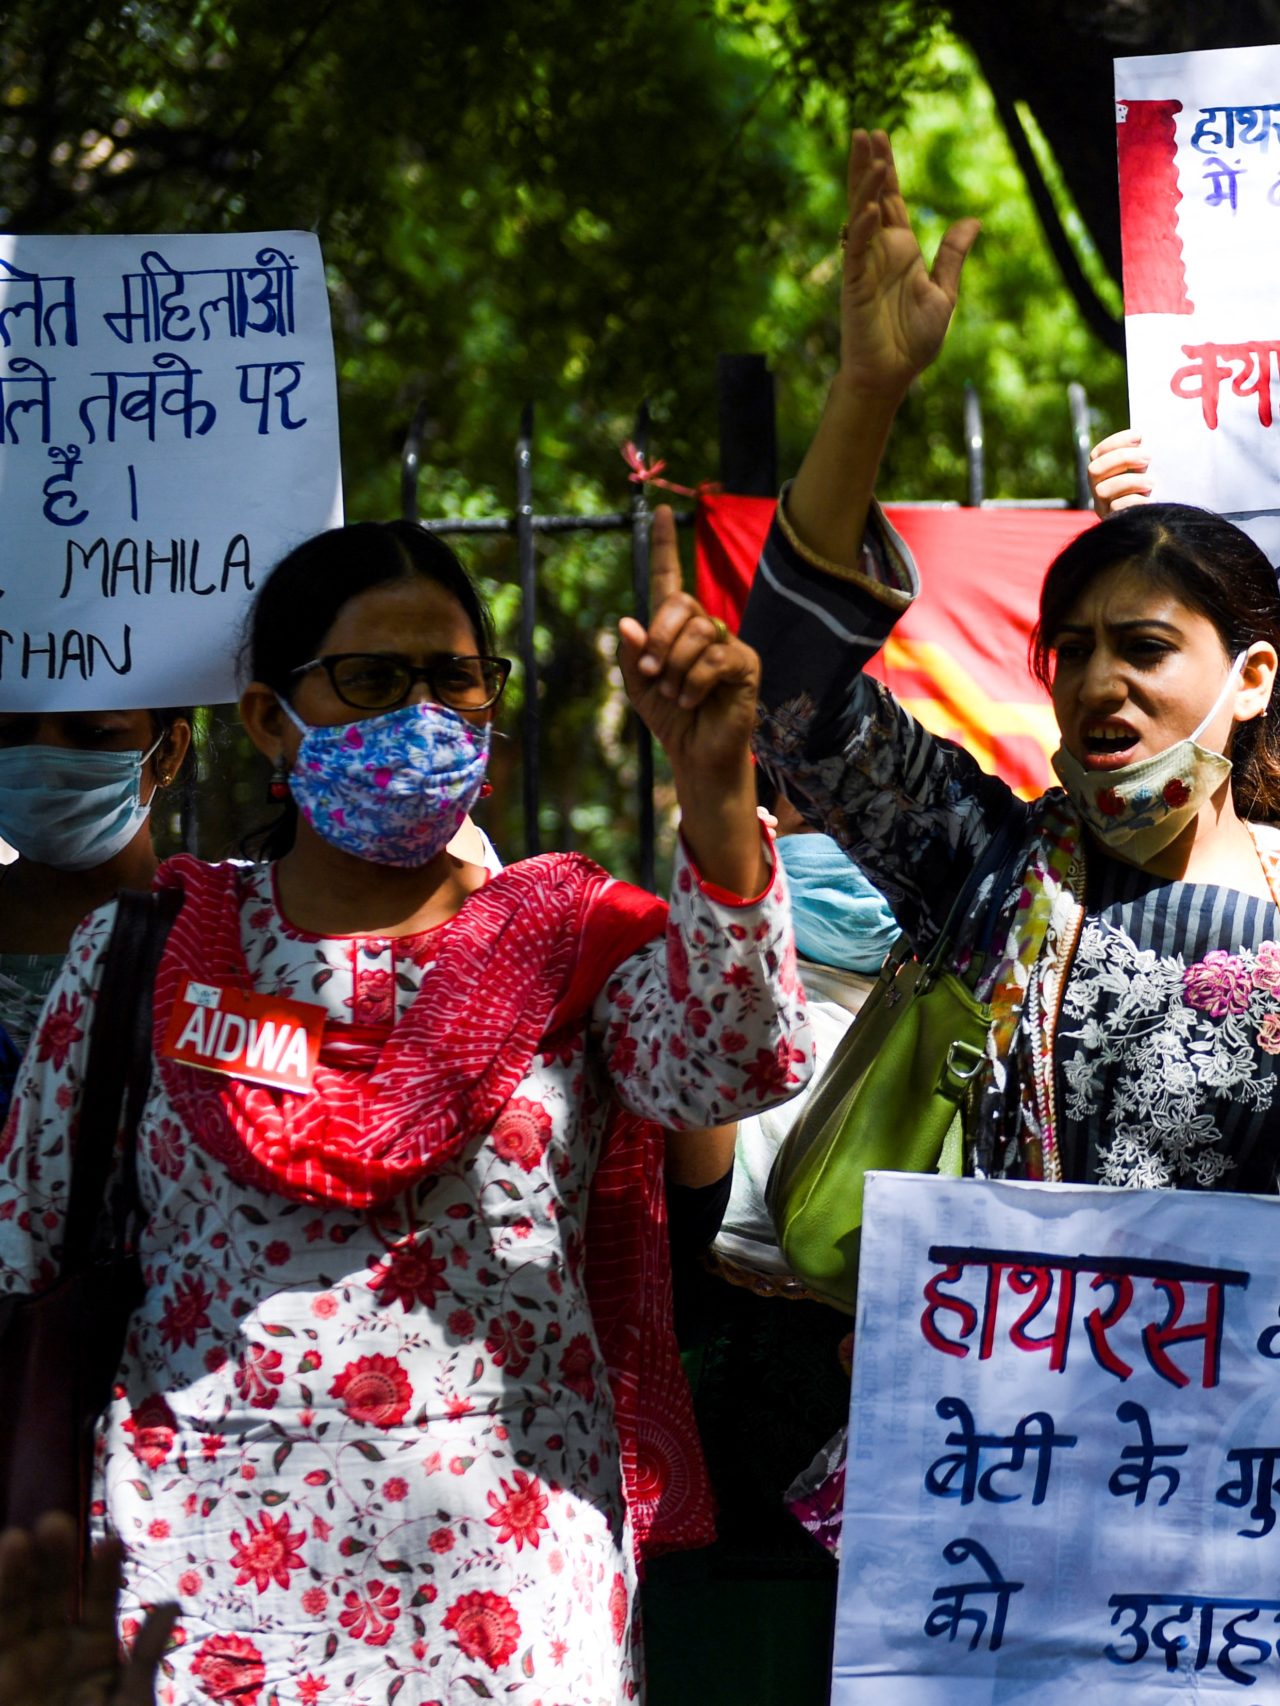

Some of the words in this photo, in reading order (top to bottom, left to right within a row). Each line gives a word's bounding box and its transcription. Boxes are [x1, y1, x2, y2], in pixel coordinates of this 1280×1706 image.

[1202, 156, 1247, 216] में
[103, 246, 300, 345] महिलाओं
[79, 352, 216, 444] तबके
[235, 361, 307, 436] पर
[42, 443, 90, 527] है
[60, 532, 256, 600] MAHILA
[174, 1005, 309, 1079] AIDWA
[920, 1245, 1250, 1388] हाथरस
[925, 1396, 1077, 1506] बेटी
[1108, 1400, 1188, 1507] के
[924, 1538, 1024, 1651] को
